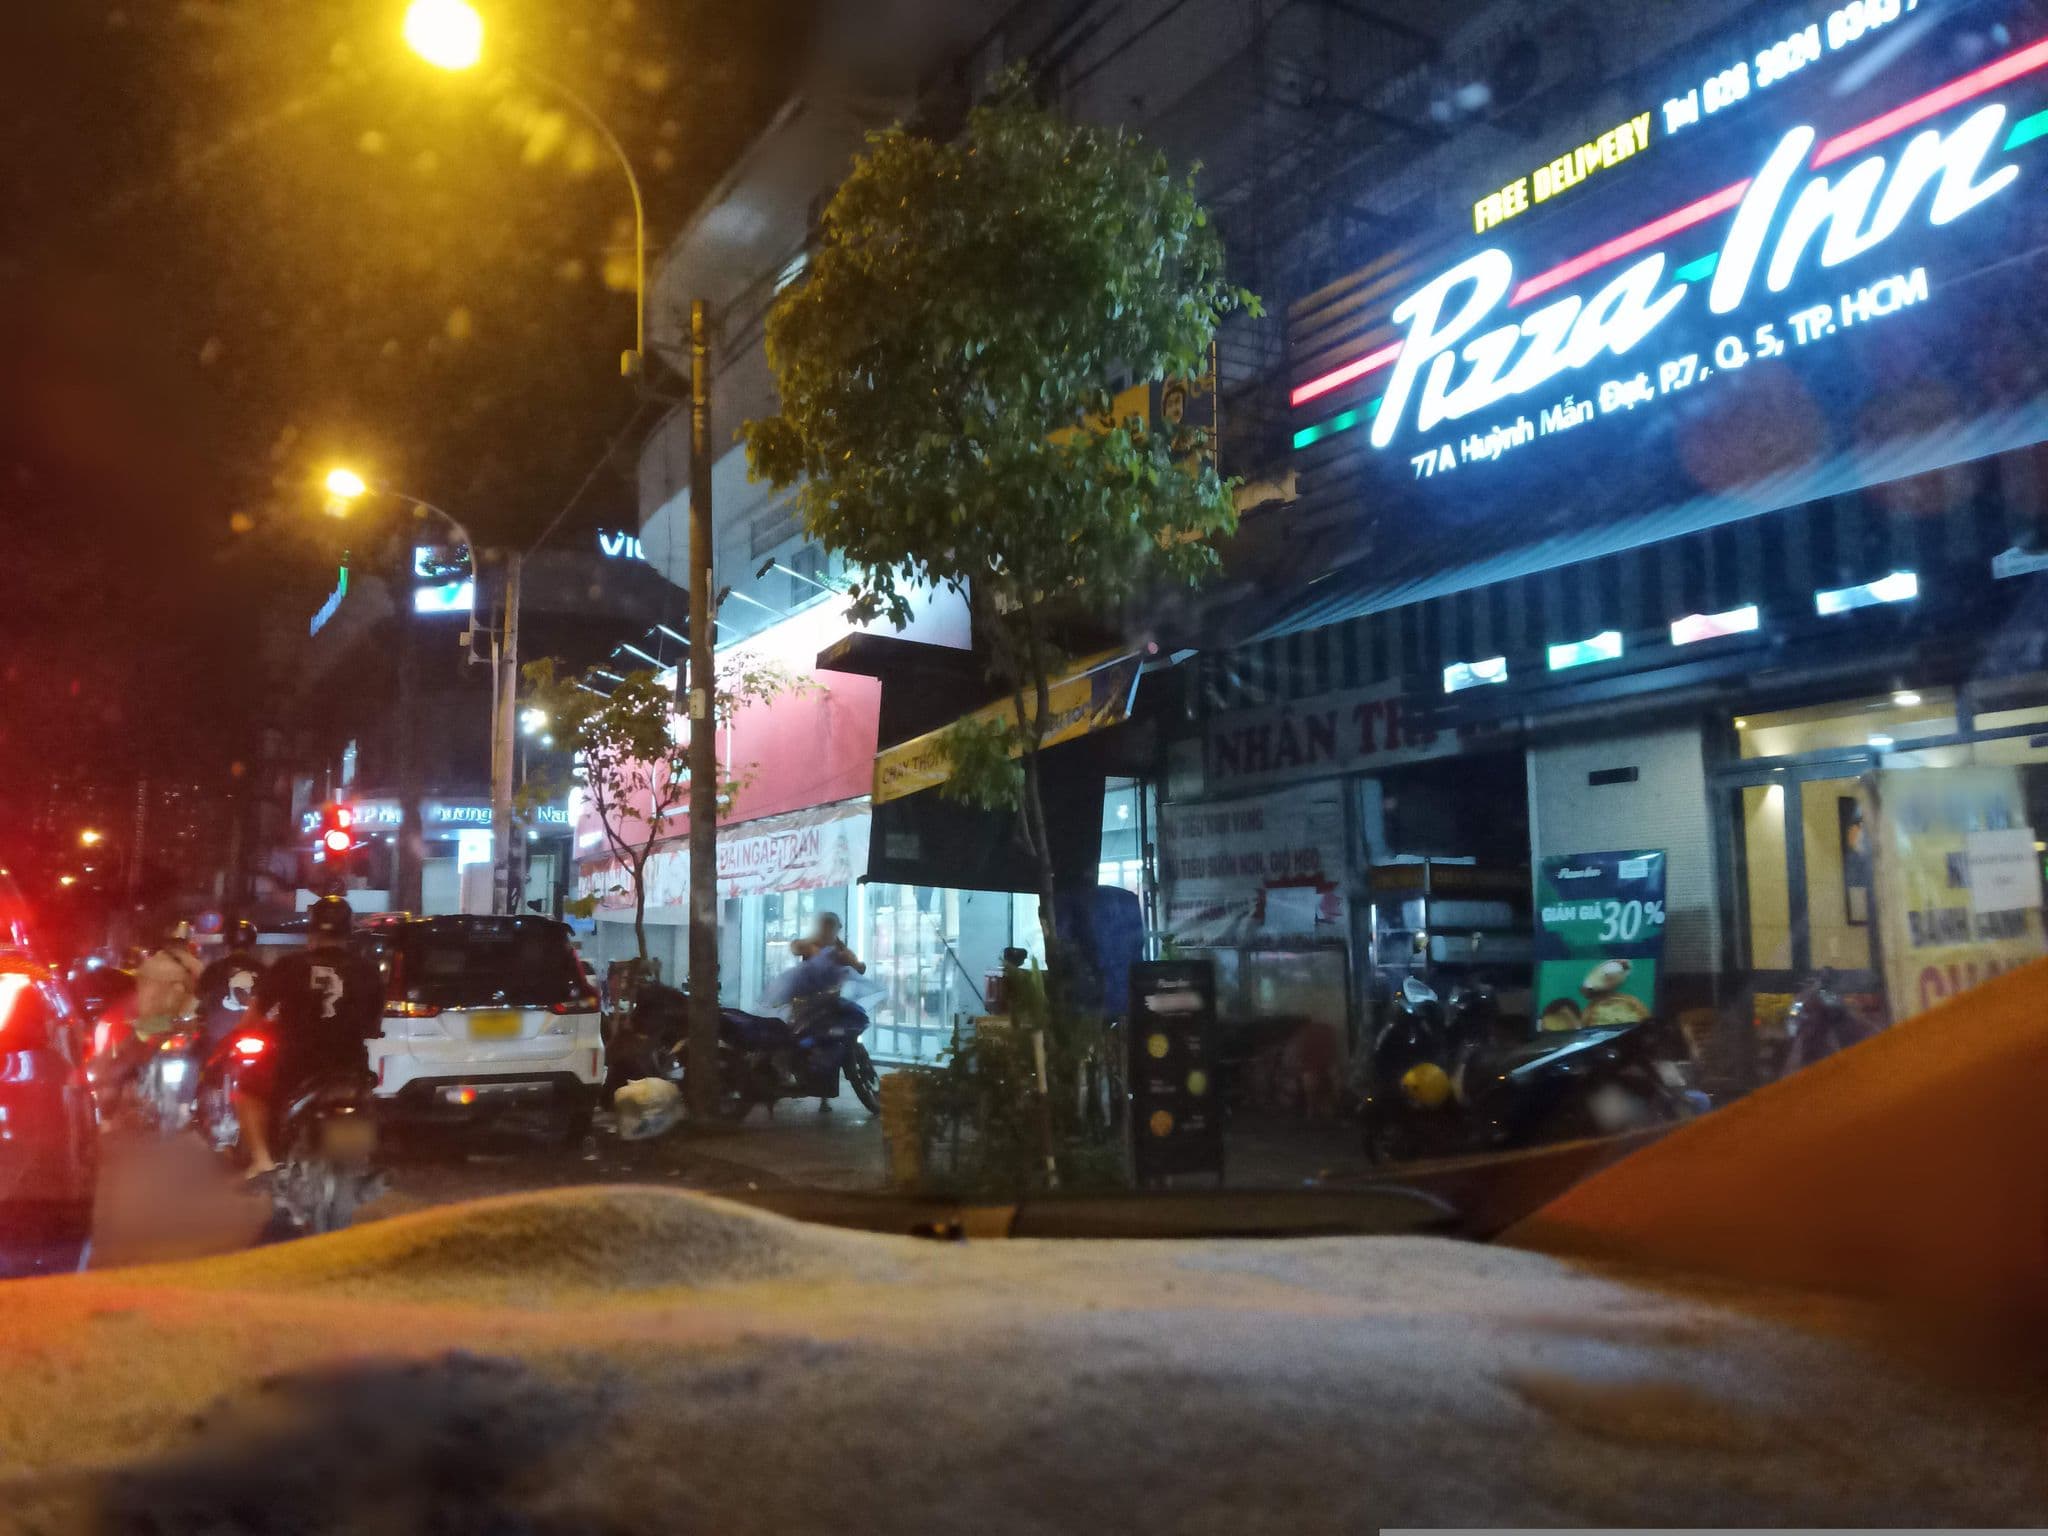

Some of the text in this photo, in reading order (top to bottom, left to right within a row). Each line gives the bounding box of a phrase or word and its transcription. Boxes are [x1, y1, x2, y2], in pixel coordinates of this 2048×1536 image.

[1474, 177, 1529, 234] FREE
[1533, 112, 1651, 204] DELIVERY
[1371, 104, 2020, 448] Pizza Inn
[1411, 444, 1457, 480] 77A
[1461, 415, 1534, 463] Huỳnh
[1788, 303, 1837, 346] TP.
[1840, 267, 1929, 327] HCM
[1598, 900, 1666, 941] 30%
